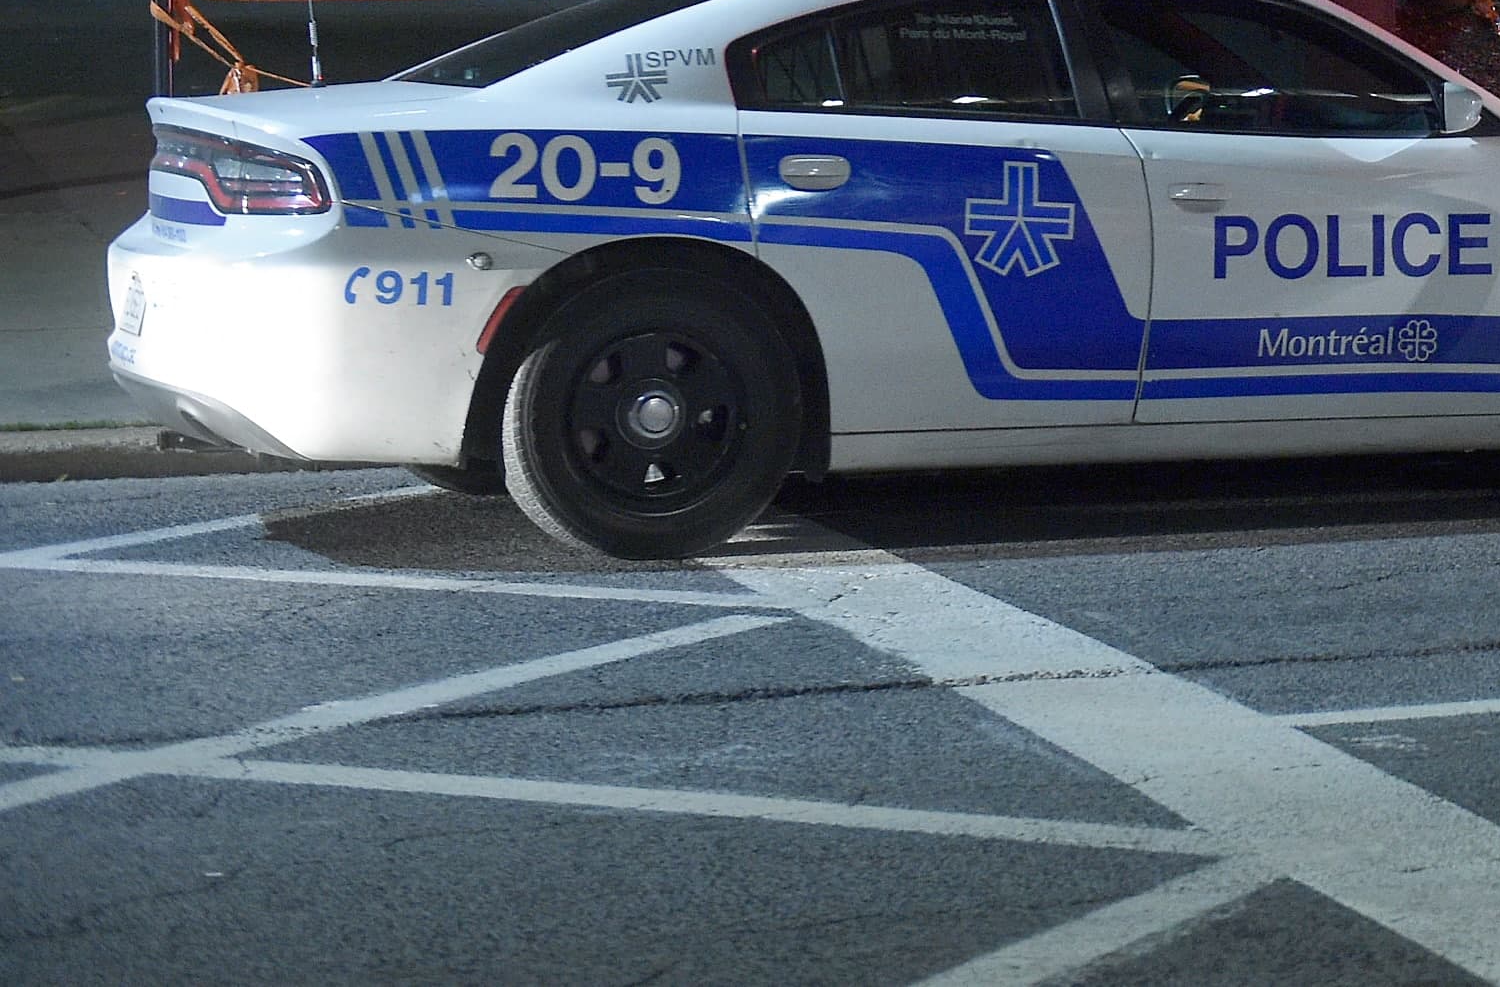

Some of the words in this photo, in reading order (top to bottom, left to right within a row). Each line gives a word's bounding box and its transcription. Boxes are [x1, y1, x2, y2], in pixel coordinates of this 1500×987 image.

[932, 27, 950, 39] du
[644, 47, 716, 69] SPVM
[488, 132, 682, 205] 20-9
[1213, 212, 1493, 279] POLICE
[375, 270, 455, 307] 911
[1257, 326, 1394, 358] Montréal
